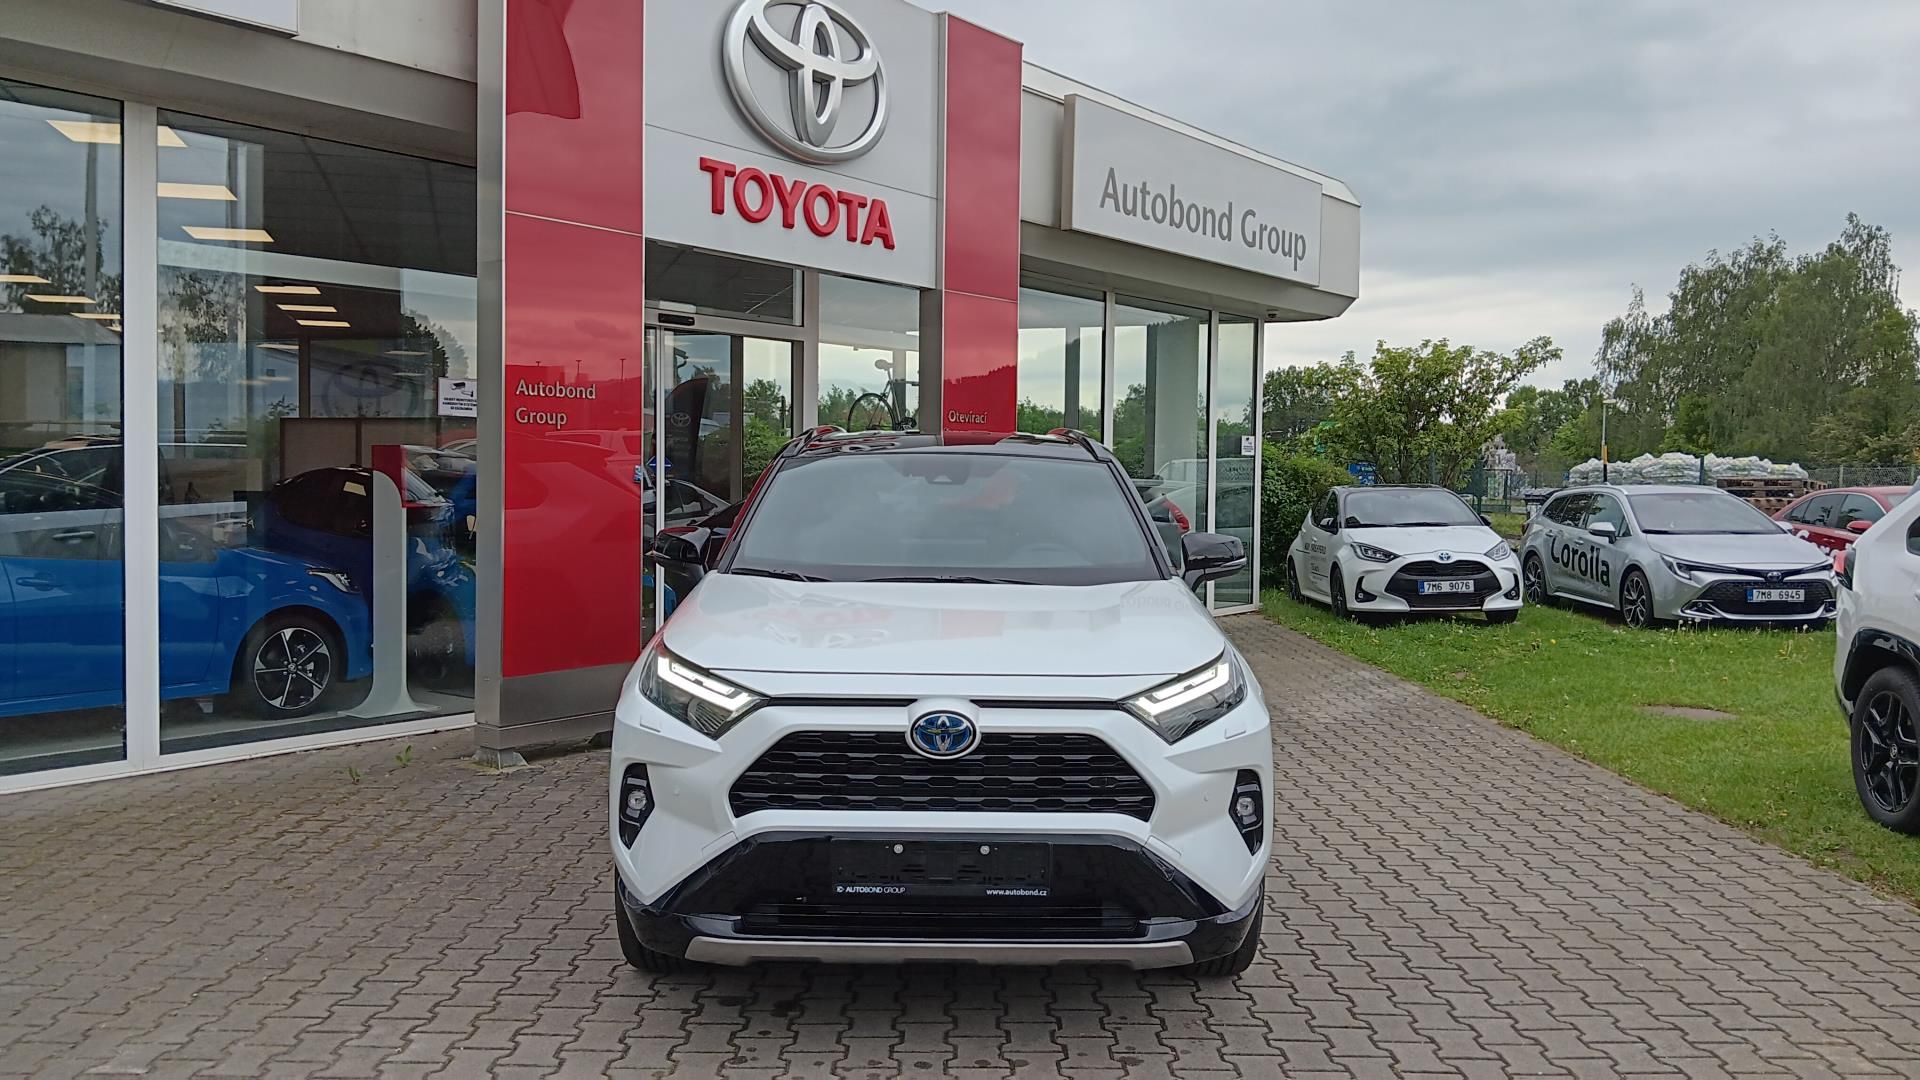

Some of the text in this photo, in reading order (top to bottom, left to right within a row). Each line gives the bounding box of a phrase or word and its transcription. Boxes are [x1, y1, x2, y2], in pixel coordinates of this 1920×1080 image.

[699, 156, 896, 250] TOYOTA
[1100, 166, 1307, 272] Autobond Group
[515, 379, 597, 399] Autobond
[515, 407, 568, 430] Group
[948, 410, 988, 424] Otevírací
[1550, 535, 1611, 588] Corolla
[1426, 581, 1471, 592] 7M6 9076
[1755, 590, 1801, 600] 7M8 6945
[883, 886, 906, 894] GROUP
[986, 888, 1048, 896] www.autobond.cz
